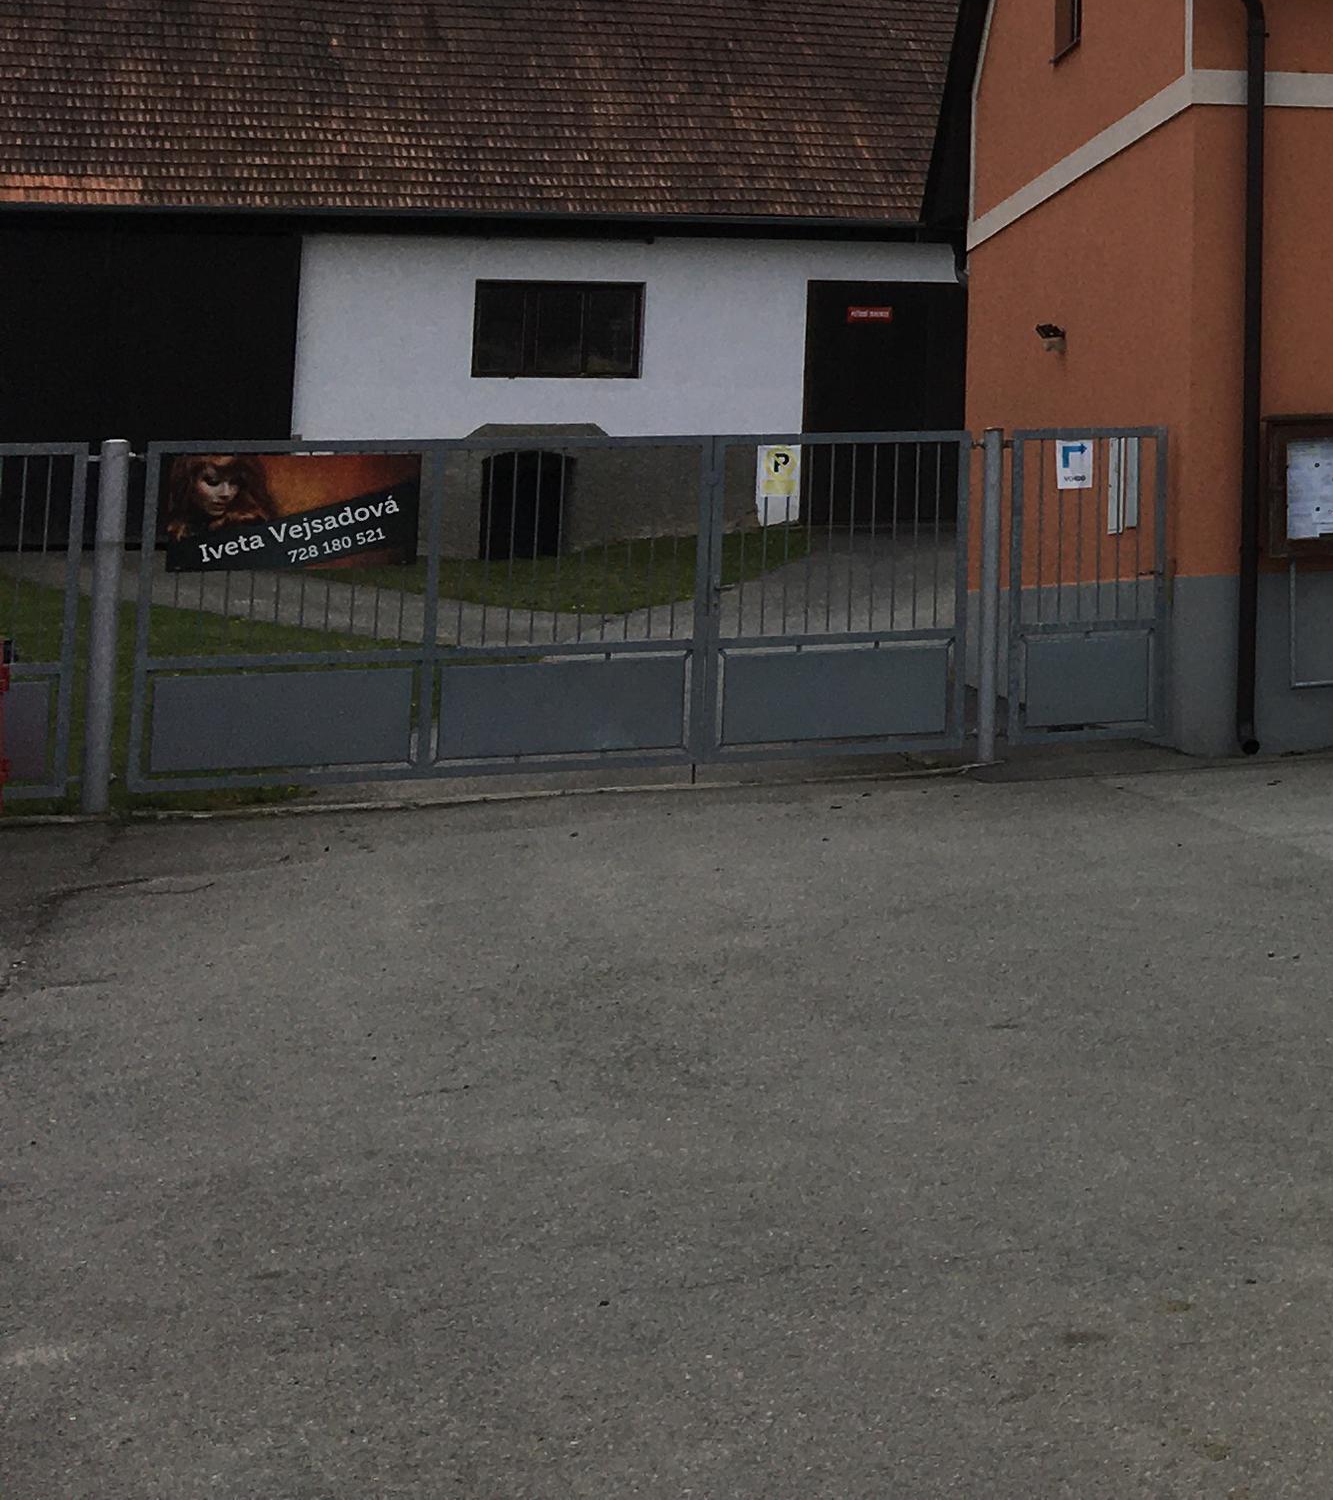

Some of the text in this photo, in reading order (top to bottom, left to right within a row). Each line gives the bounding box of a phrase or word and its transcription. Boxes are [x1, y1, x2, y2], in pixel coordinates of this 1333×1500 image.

[774, 453, 789, 473] P
[199, 495, 400, 562] Iveta Vejsadová
[287, 527, 386, 563] 728 180 521
